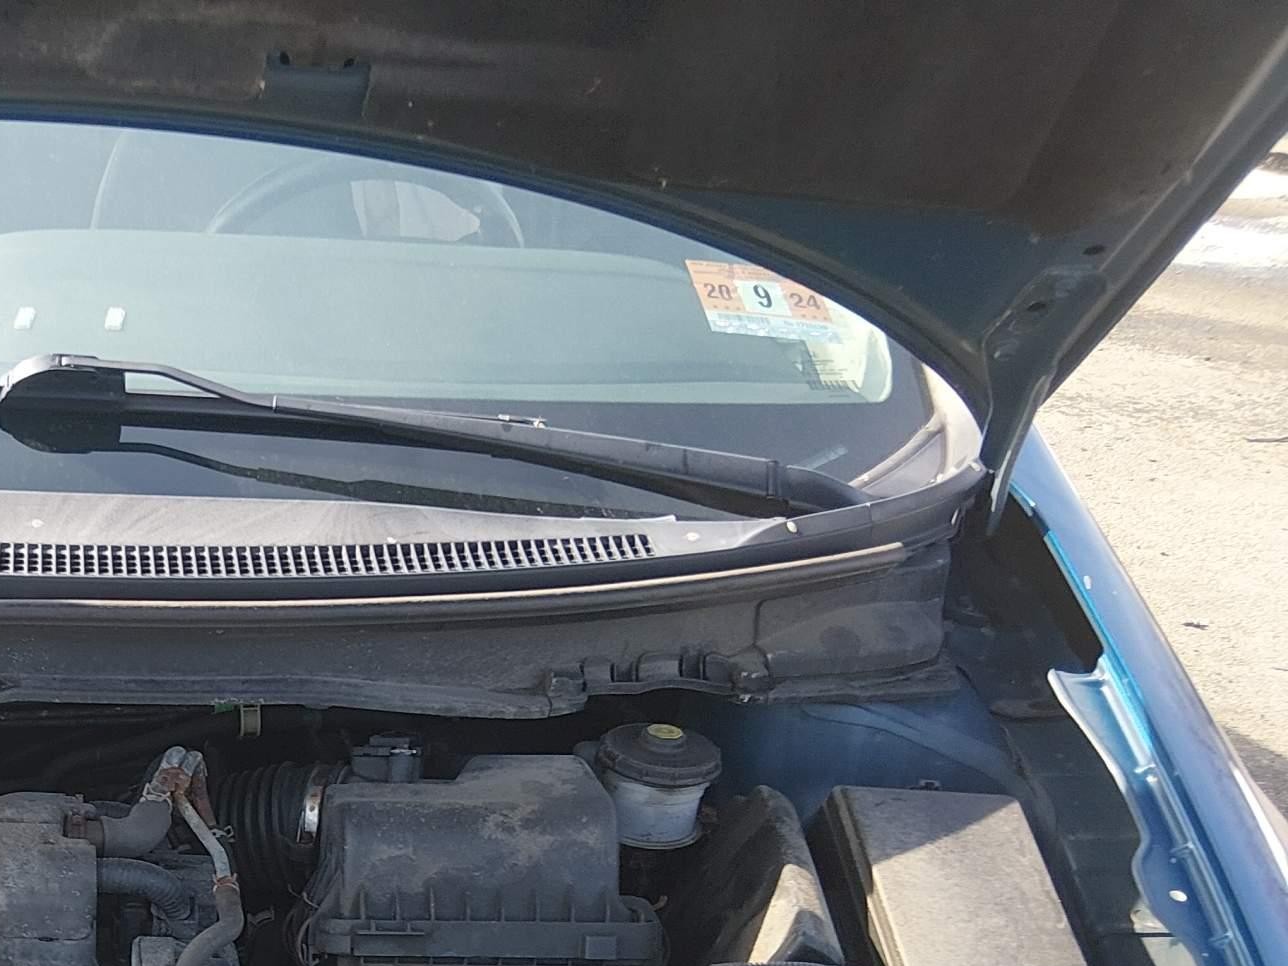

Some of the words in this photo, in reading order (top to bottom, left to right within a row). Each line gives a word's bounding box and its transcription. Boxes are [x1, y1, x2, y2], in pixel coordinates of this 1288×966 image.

[703, 282, 733, 301] 20
[752, 283, 773, 309] 9
[788, 292, 822, 310] 24
